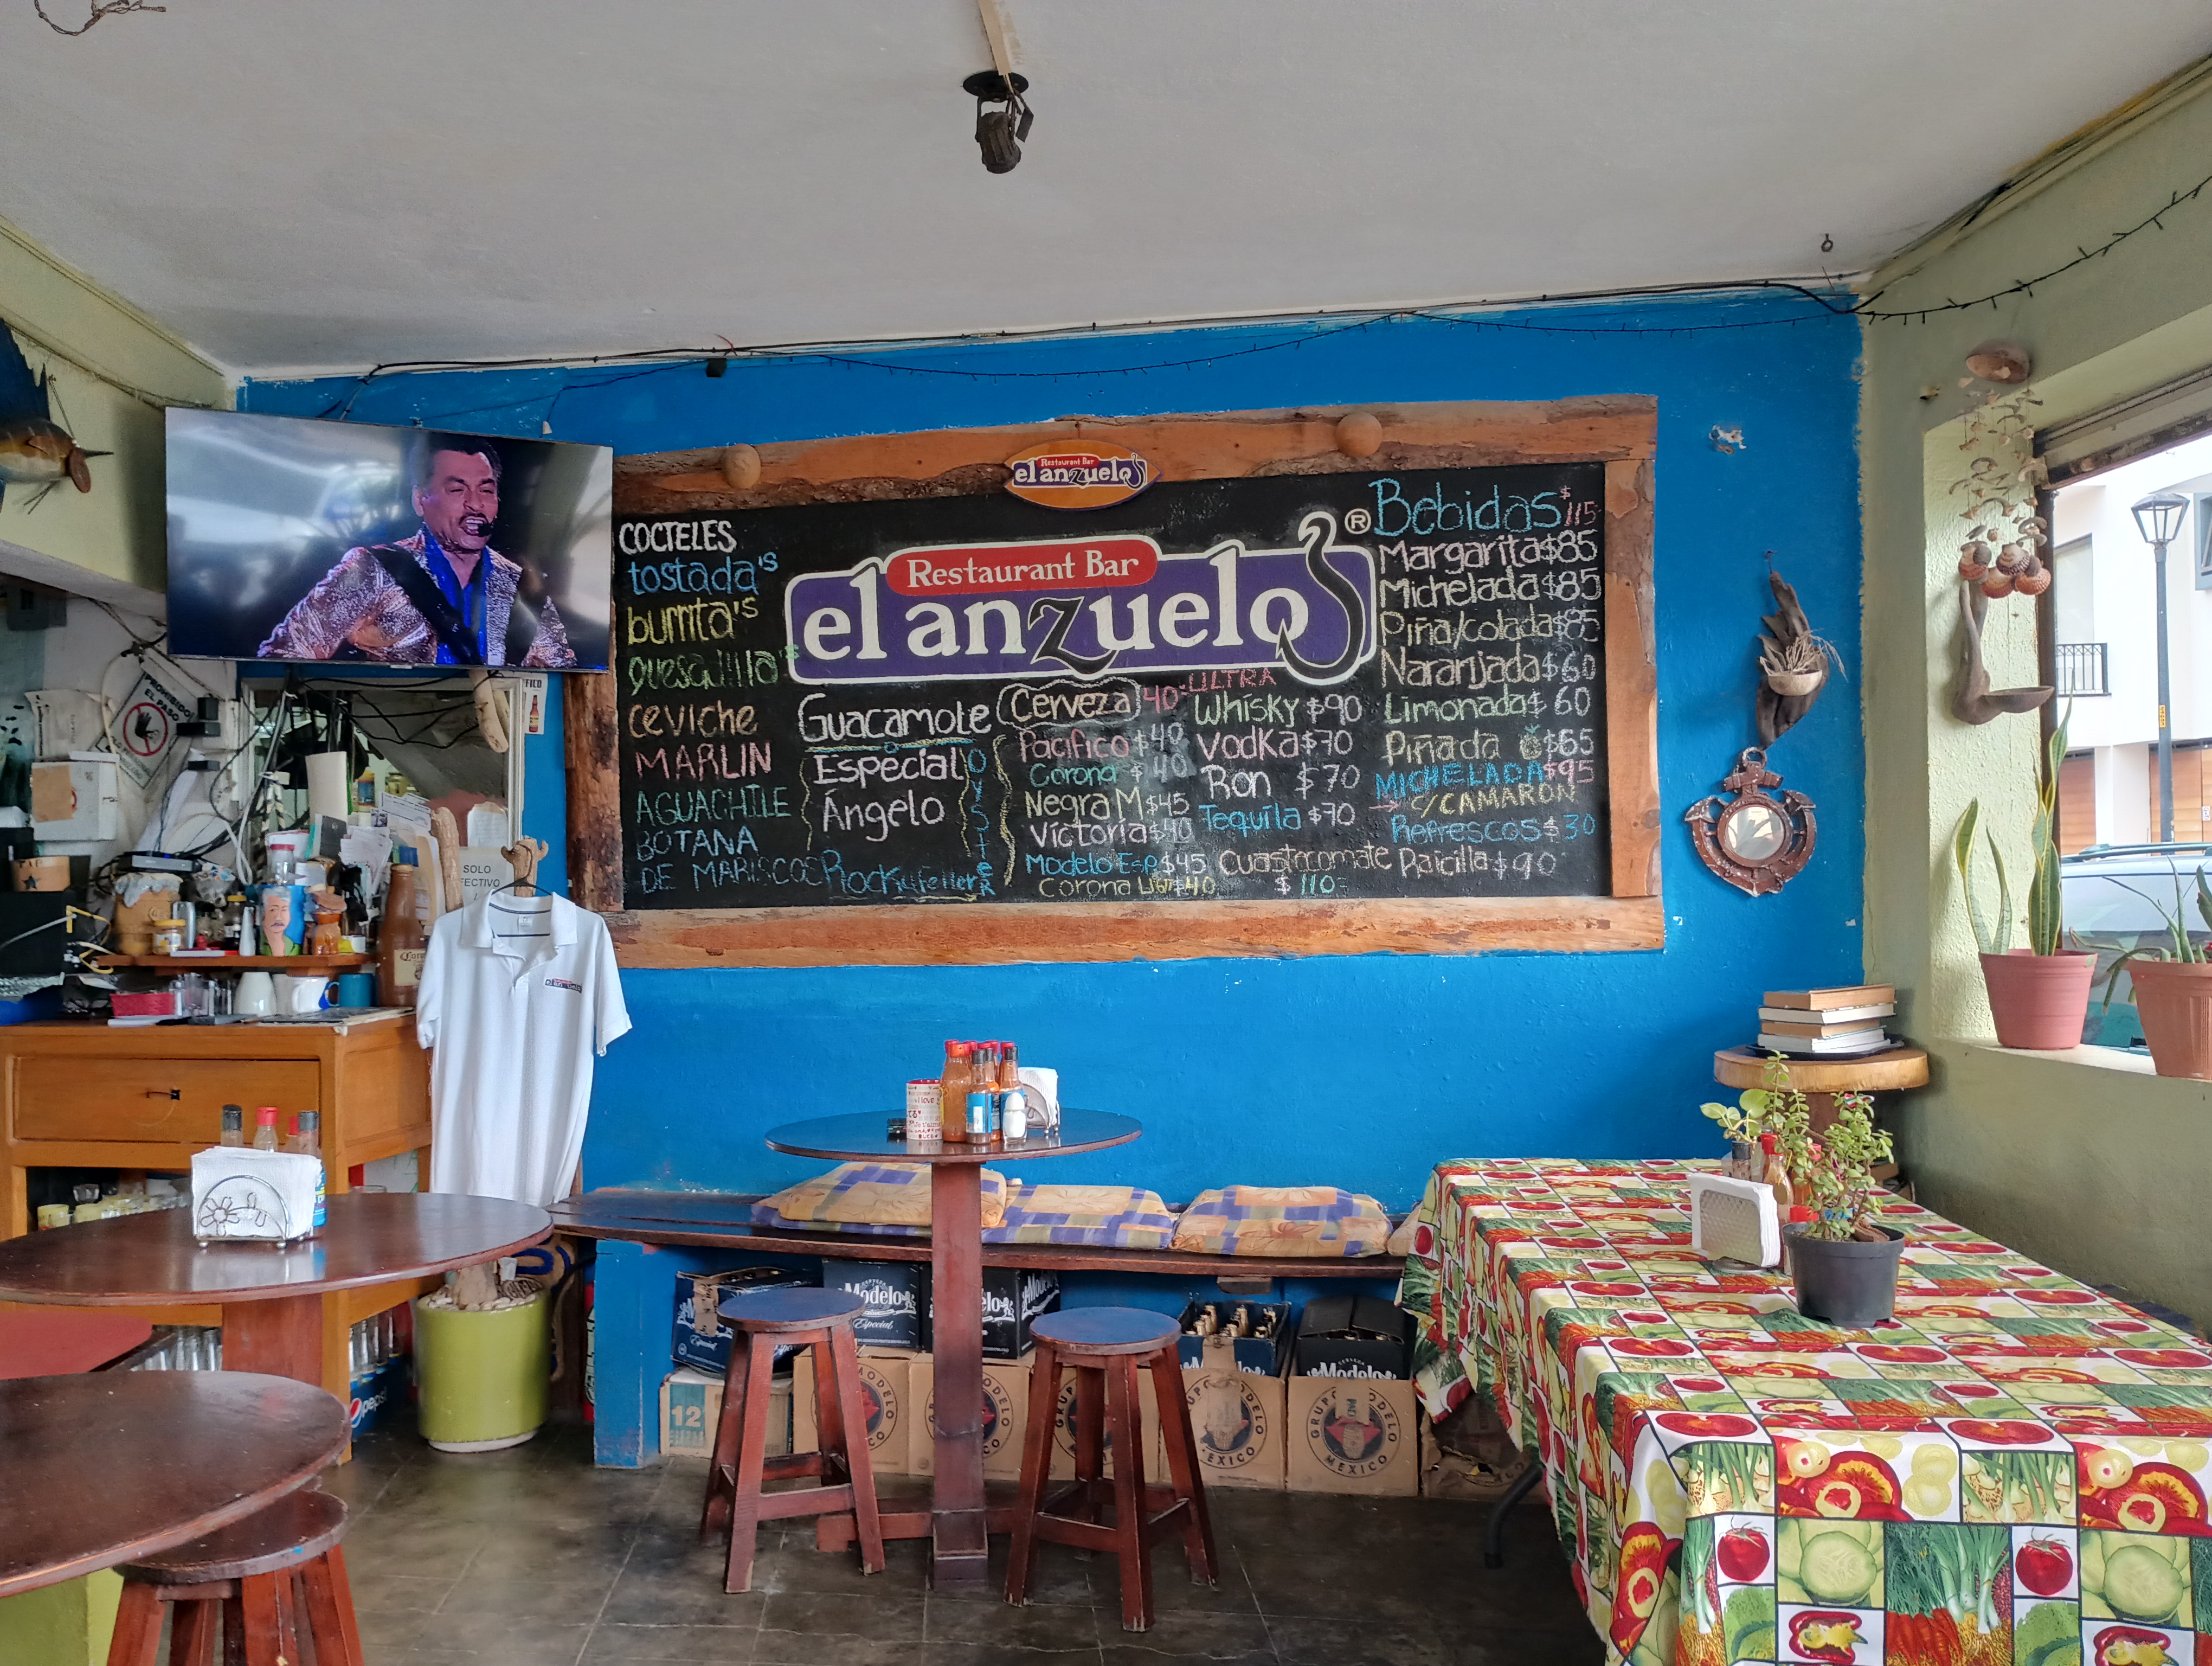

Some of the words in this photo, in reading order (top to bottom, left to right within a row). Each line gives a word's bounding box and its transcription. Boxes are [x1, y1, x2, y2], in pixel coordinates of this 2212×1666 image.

[1014, 459, 1037, 483] el
[1040, 458, 1132, 486] anzuelo
[1040, 458, 1081, 466] Restaurant
[1368, 478, 1561, 537] Bebidas
[619, 520, 737, 554] COCTELES
[1379, 534, 1540, 574] Margarita
[1540, 529, 1598, 565] $85
[906, 559, 1077, 588] Restaurant
[1084, 549, 1140, 578] Bar
[1380, 566, 1540, 608] Michelada
[1542, 567, 1602, 601] $85
[803, 565, 888, 660] el
[905, 552, 1309, 675] anzuelo
[1381, 643, 1540, 689] Naranjada
[144, 672, 192, 718] PROHIBIDO
[144, 688, 155, 701] EL
[156, 699, 179, 721] PASO
[1011, 688, 1131, 722] Cerveza
[1307, 693, 1362, 726] $90
[1384, 683, 1527, 724] Limonada
[798, 693, 992, 742] Guacamole
[1020, 728, 1130, 763] Pacifico
[1301, 729, 1354, 755] $70
[635, 742, 771, 781] MARLIN
[813, 746, 964, 789] Especial
[1030, 763, 1117, 788] Corona
[1200, 764, 1272, 800] Ron
[1375, 760, 1544, 800] MICHELADA
[636, 784, 792, 827] AGUACHILE
[1115, 786, 1143, 820] M
[1145, 791, 1190, 817] $45
[1308, 802, 1355, 827] $70
[636, 825, 760, 862] BOTANA
[1390, 814, 1542, 844] Refrescos
[463, 864, 491, 874] SOLO
[640, 863, 677, 894] DE
[1025, 851, 1113, 876] Modelo
[1161, 851, 1207, 875] $45
[1039, 878, 1131, 898] Corona
[852, 1318, 895, 1330] Especial
[671, 1405, 702, 1428] 12
[982, 1377, 1010, 1427] ODELO
[1369, 1392, 1398, 1442] ODELO
[1202, 1446, 1255, 1466] EXICO
[1324, 1454, 1387, 1475] MEXICO
